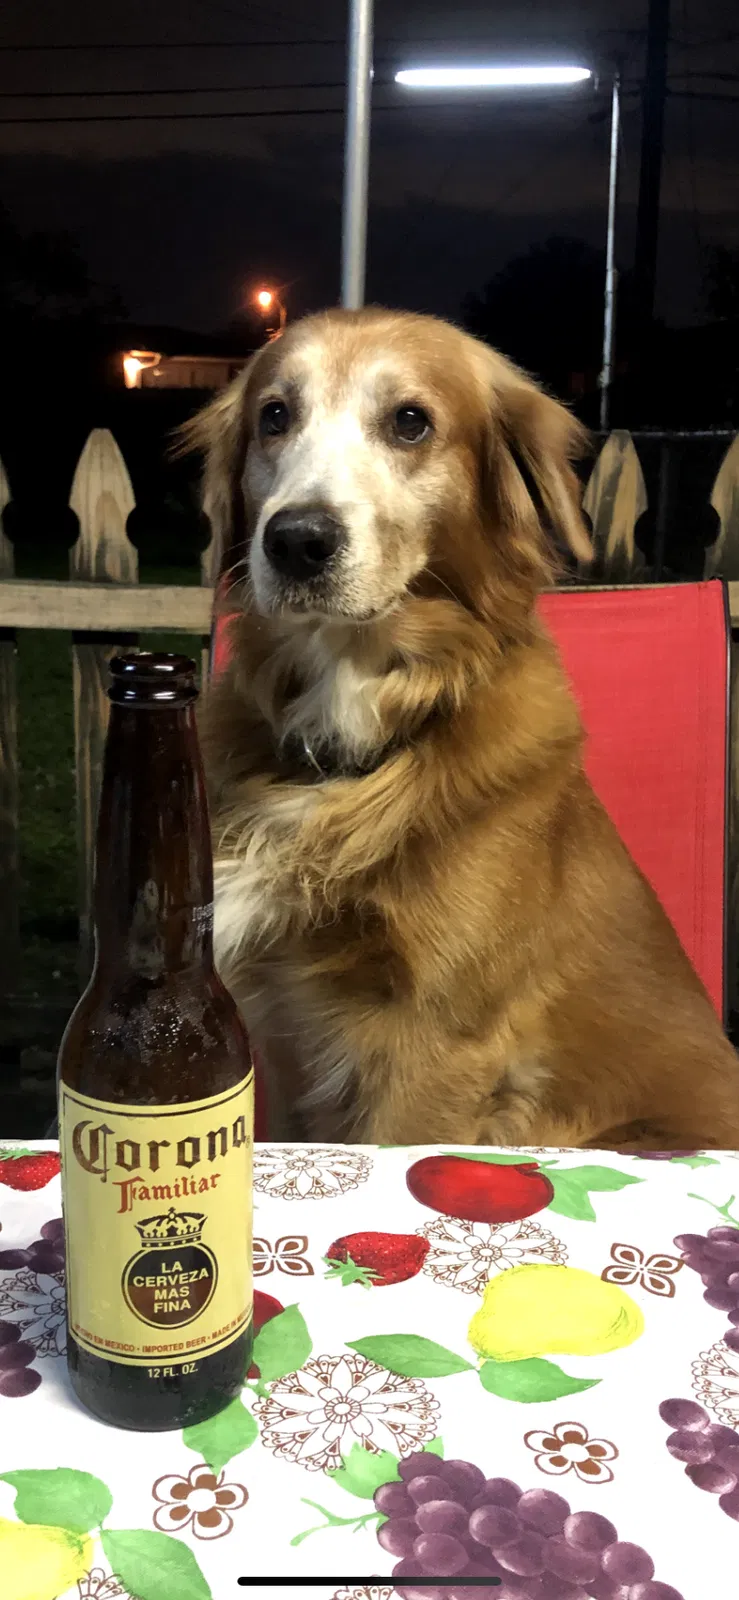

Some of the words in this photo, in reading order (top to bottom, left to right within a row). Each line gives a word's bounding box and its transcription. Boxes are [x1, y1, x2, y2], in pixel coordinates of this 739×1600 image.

[72, 1115, 246, 1183] Corona
[112, 1173, 221, 1214] Familiar
[161, 1261, 183, 1274] LA
[133, 1267, 209, 1287] CERVEZA
[154, 1286, 190, 1300] MAS
[153, 1298, 191, 1314] FINA
[104, 1337, 135, 1352] MEXICO
[142, 1343, 184, 1353] IMPORTED
[185, 1336, 206, 1348] BEER
[211, 1324, 230, 1340] MADE
[147, 1368, 160, 1378] 12
[163, 1367, 179, 1377] FL.
[181, 1362, 199, 1375] OZ.
